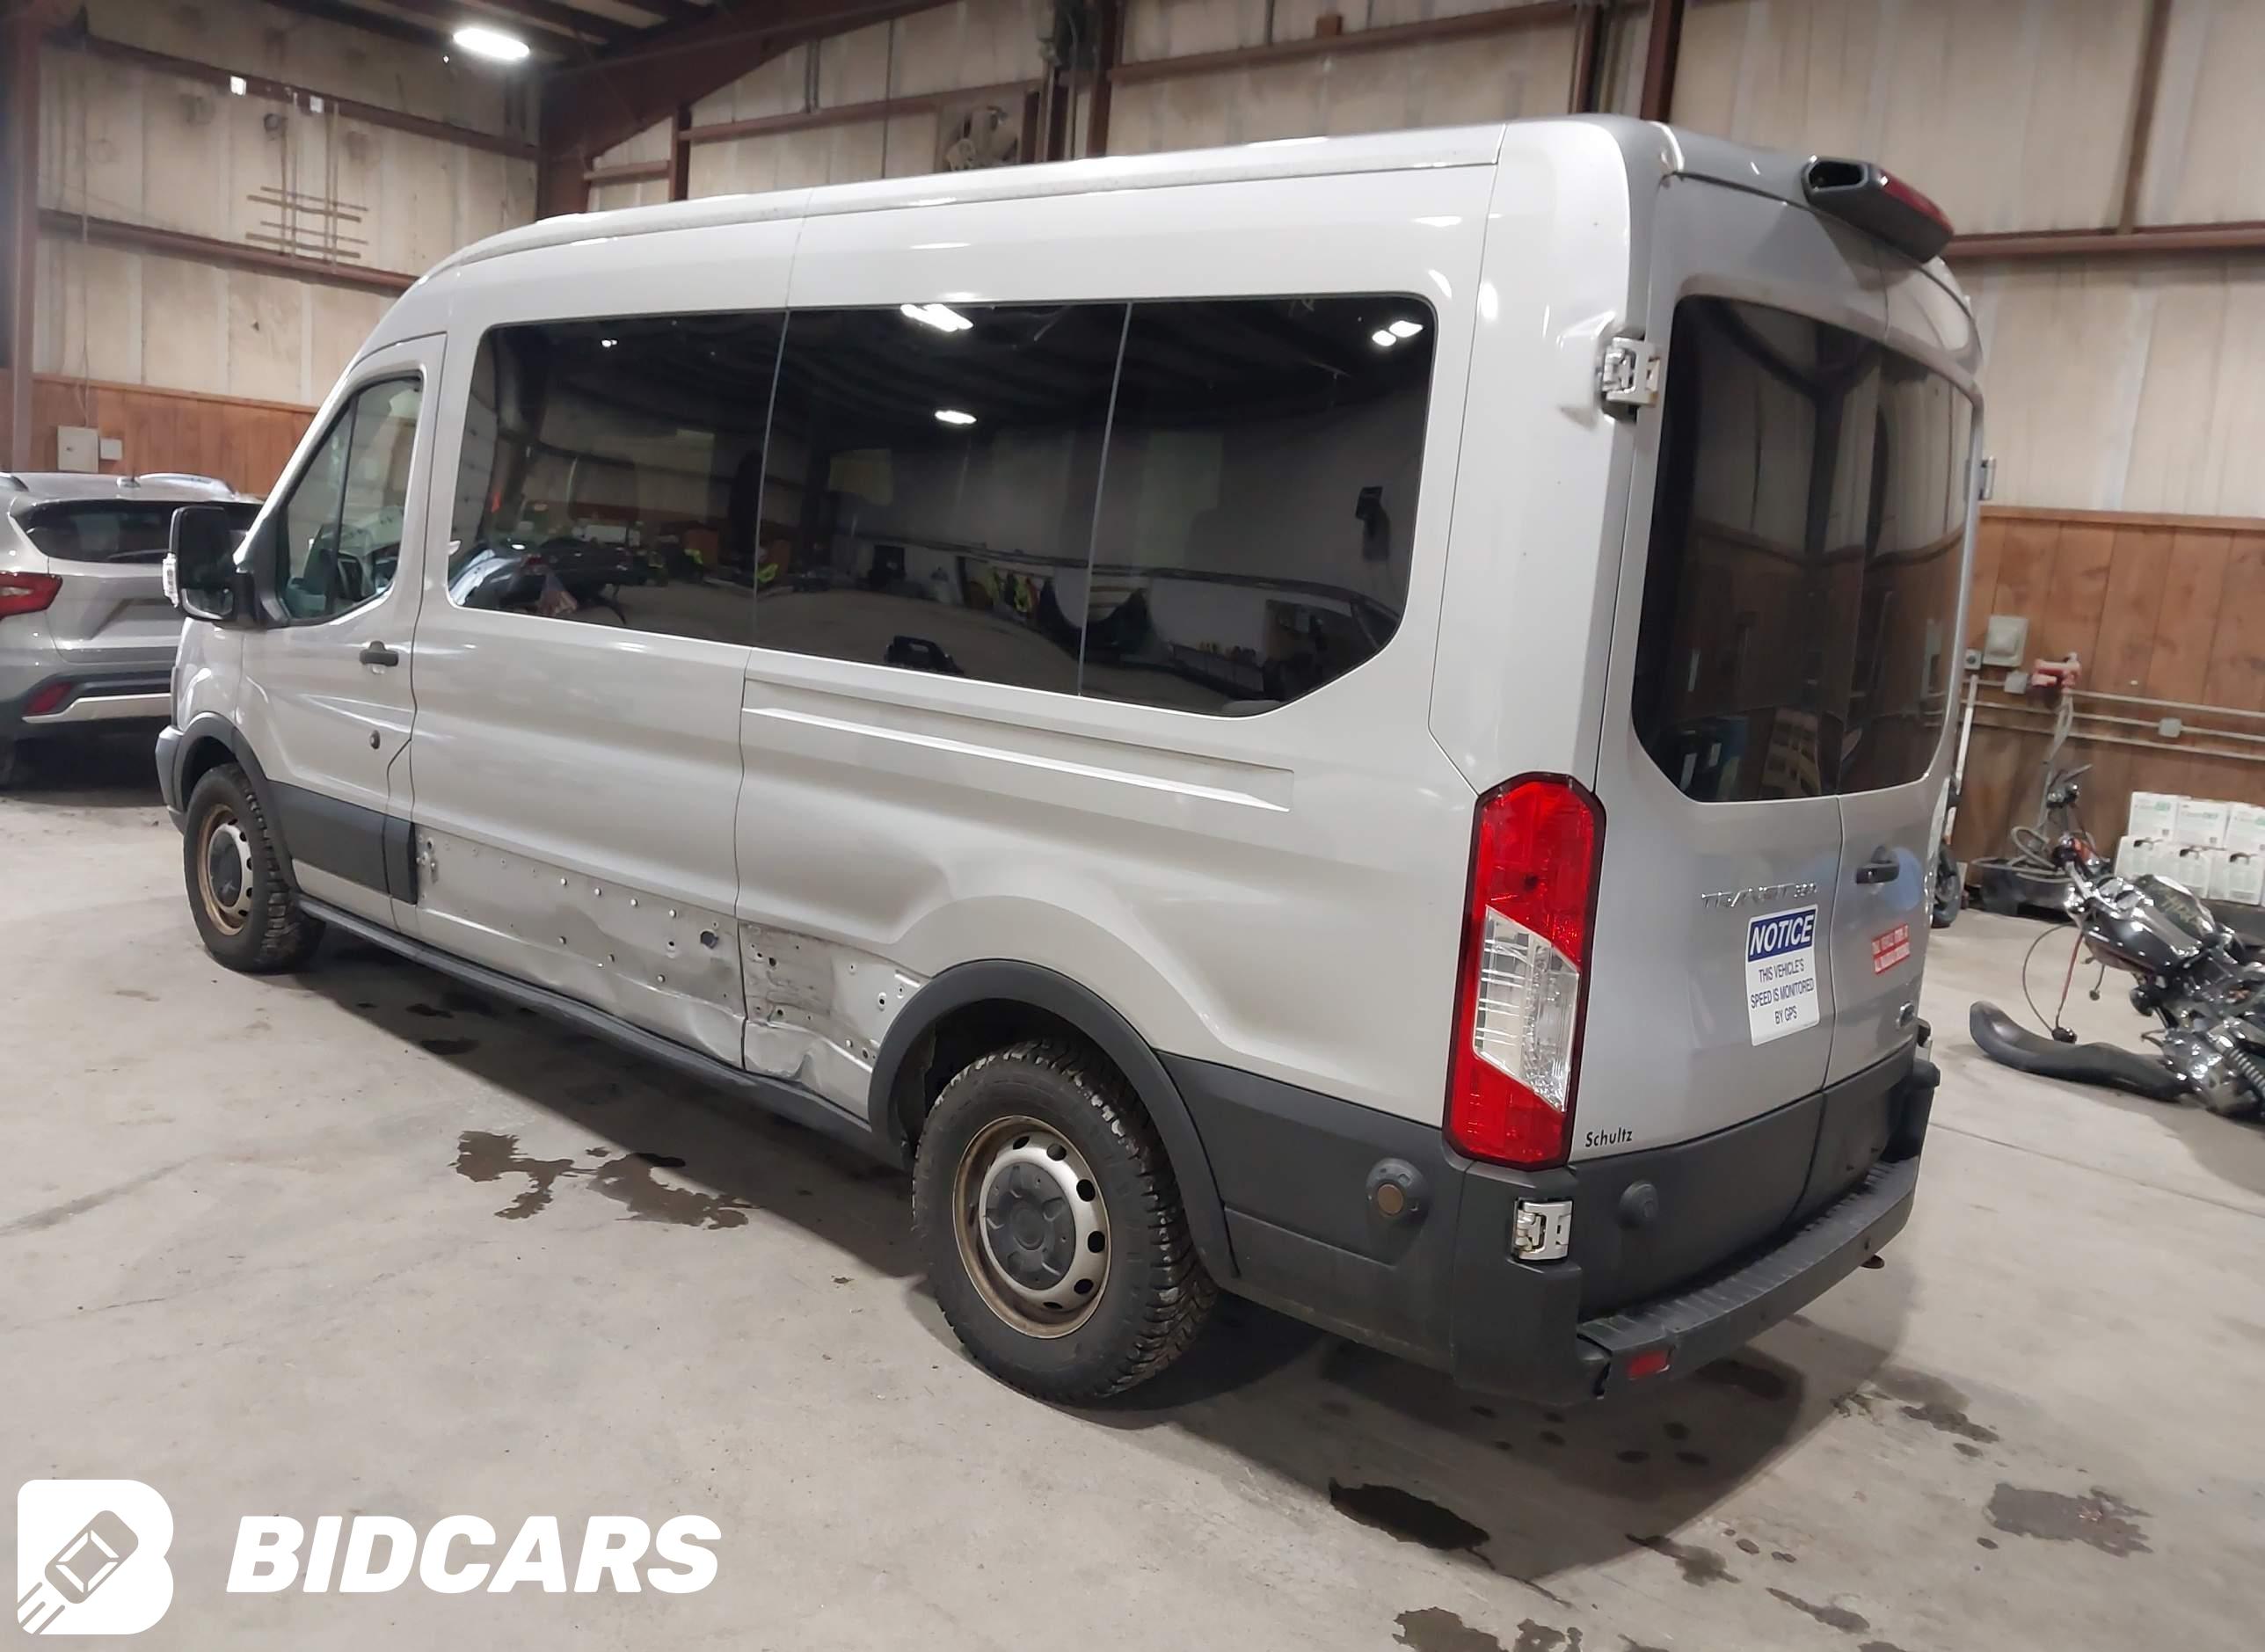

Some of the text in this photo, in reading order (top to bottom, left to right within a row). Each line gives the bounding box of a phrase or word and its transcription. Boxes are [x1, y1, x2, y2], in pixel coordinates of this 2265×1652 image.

[1750, 914, 1814, 956] NOTICE
[1759, 966, 1773, 983] THIS
[1751, 978, 1815, 1009] SPEED IS MONITORED
[1774, 1005, 1797, 1024] BY GPS
[1585, 1126, 1633, 1147] Schultz
